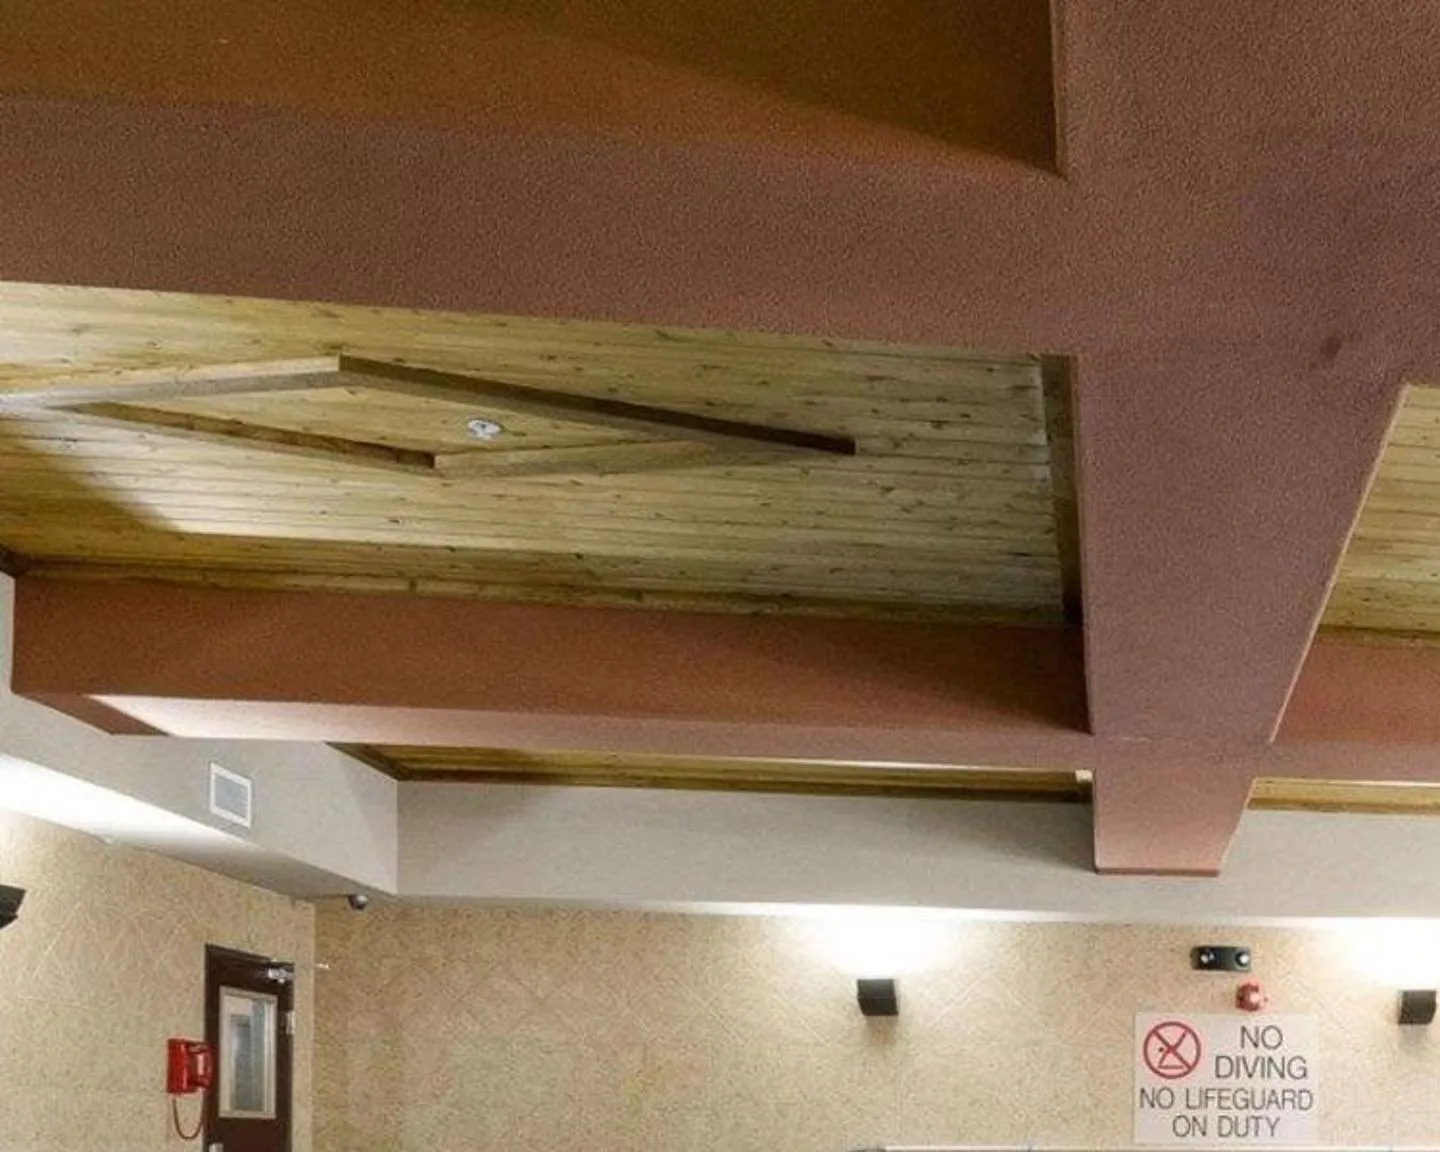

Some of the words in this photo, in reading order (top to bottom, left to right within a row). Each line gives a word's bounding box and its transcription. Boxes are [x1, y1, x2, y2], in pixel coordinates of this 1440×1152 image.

[1239, 1025, 1284, 1050] NO
[1214, 1055, 1308, 1080] DIVING
[1139, 1086, 1175, 1109] NO
[1185, 1087, 1314, 1112] LIFEGUARD
[1172, 1114, 1208, 1138] ON
[1217, 1115, 1281, 1138] DUTY
